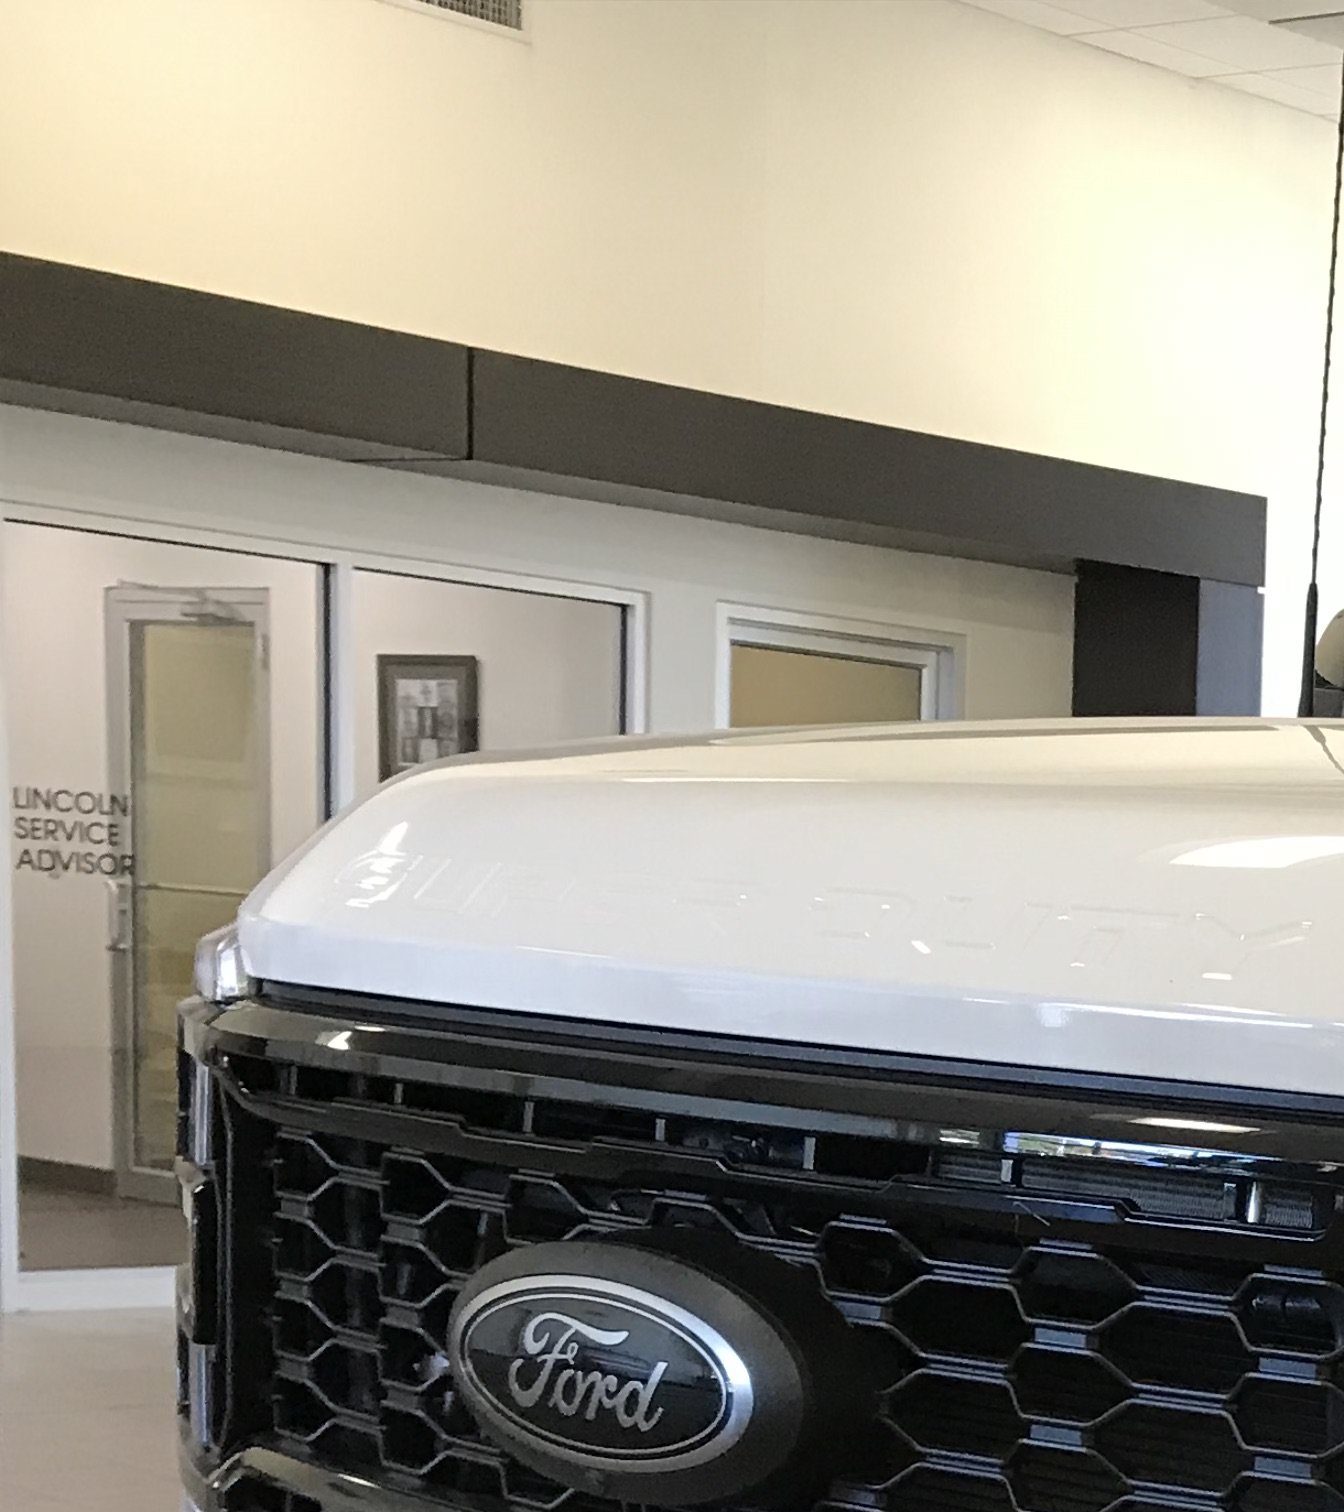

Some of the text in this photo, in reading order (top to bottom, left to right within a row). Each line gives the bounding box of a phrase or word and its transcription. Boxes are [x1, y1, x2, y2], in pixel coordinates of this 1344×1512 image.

[13, 786, 128, 816] LINCOLN
[14, 816, 120, 846] SERVICE
[16, 849, 136, 877] ADVISOR
[507, 1311, 669, 1433] Ford
